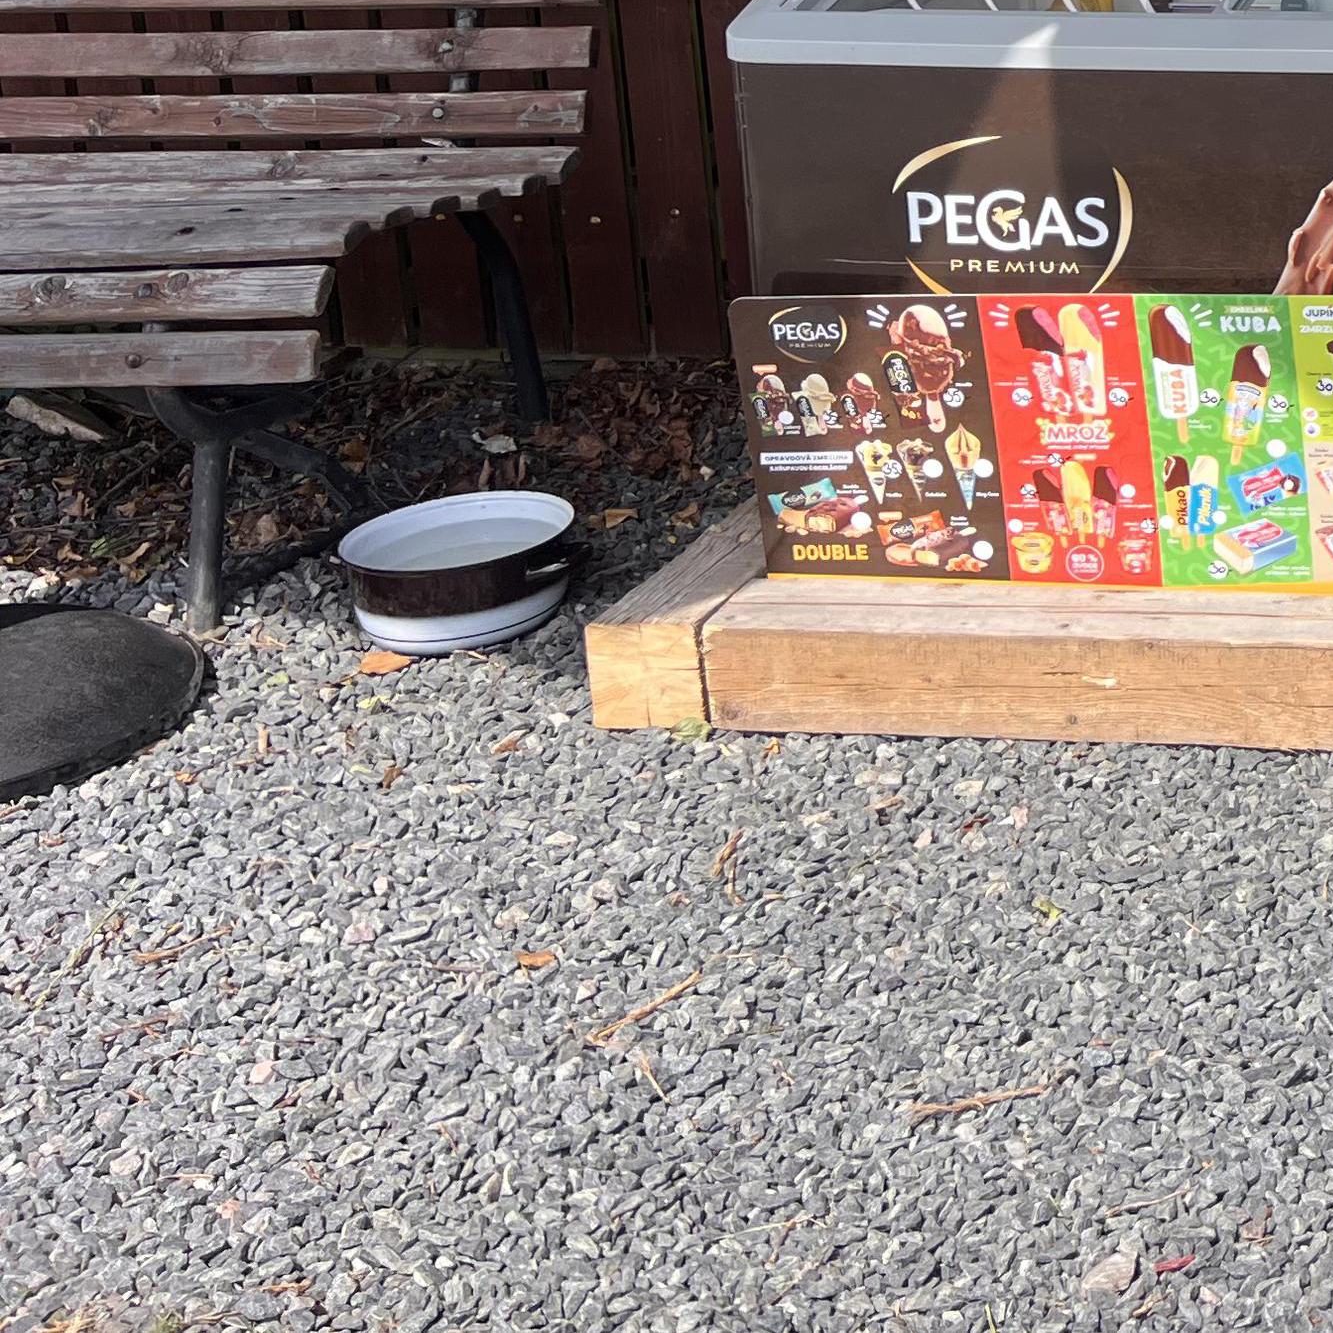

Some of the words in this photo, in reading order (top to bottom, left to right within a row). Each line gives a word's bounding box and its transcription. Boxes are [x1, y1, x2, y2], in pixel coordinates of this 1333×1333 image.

[906, 190, 1110, 252] PEGAS
[950, 259, 1081, 275] PREMIUM
[773, 322, 841, 342] PEGAS
[1220, 316, 1281, 333] KUBA
[890, 358, 912, 393] PEGAS
[1170, 369, 1187, 413] KUBA
[793, 544, 869, 561] DOUBLE
